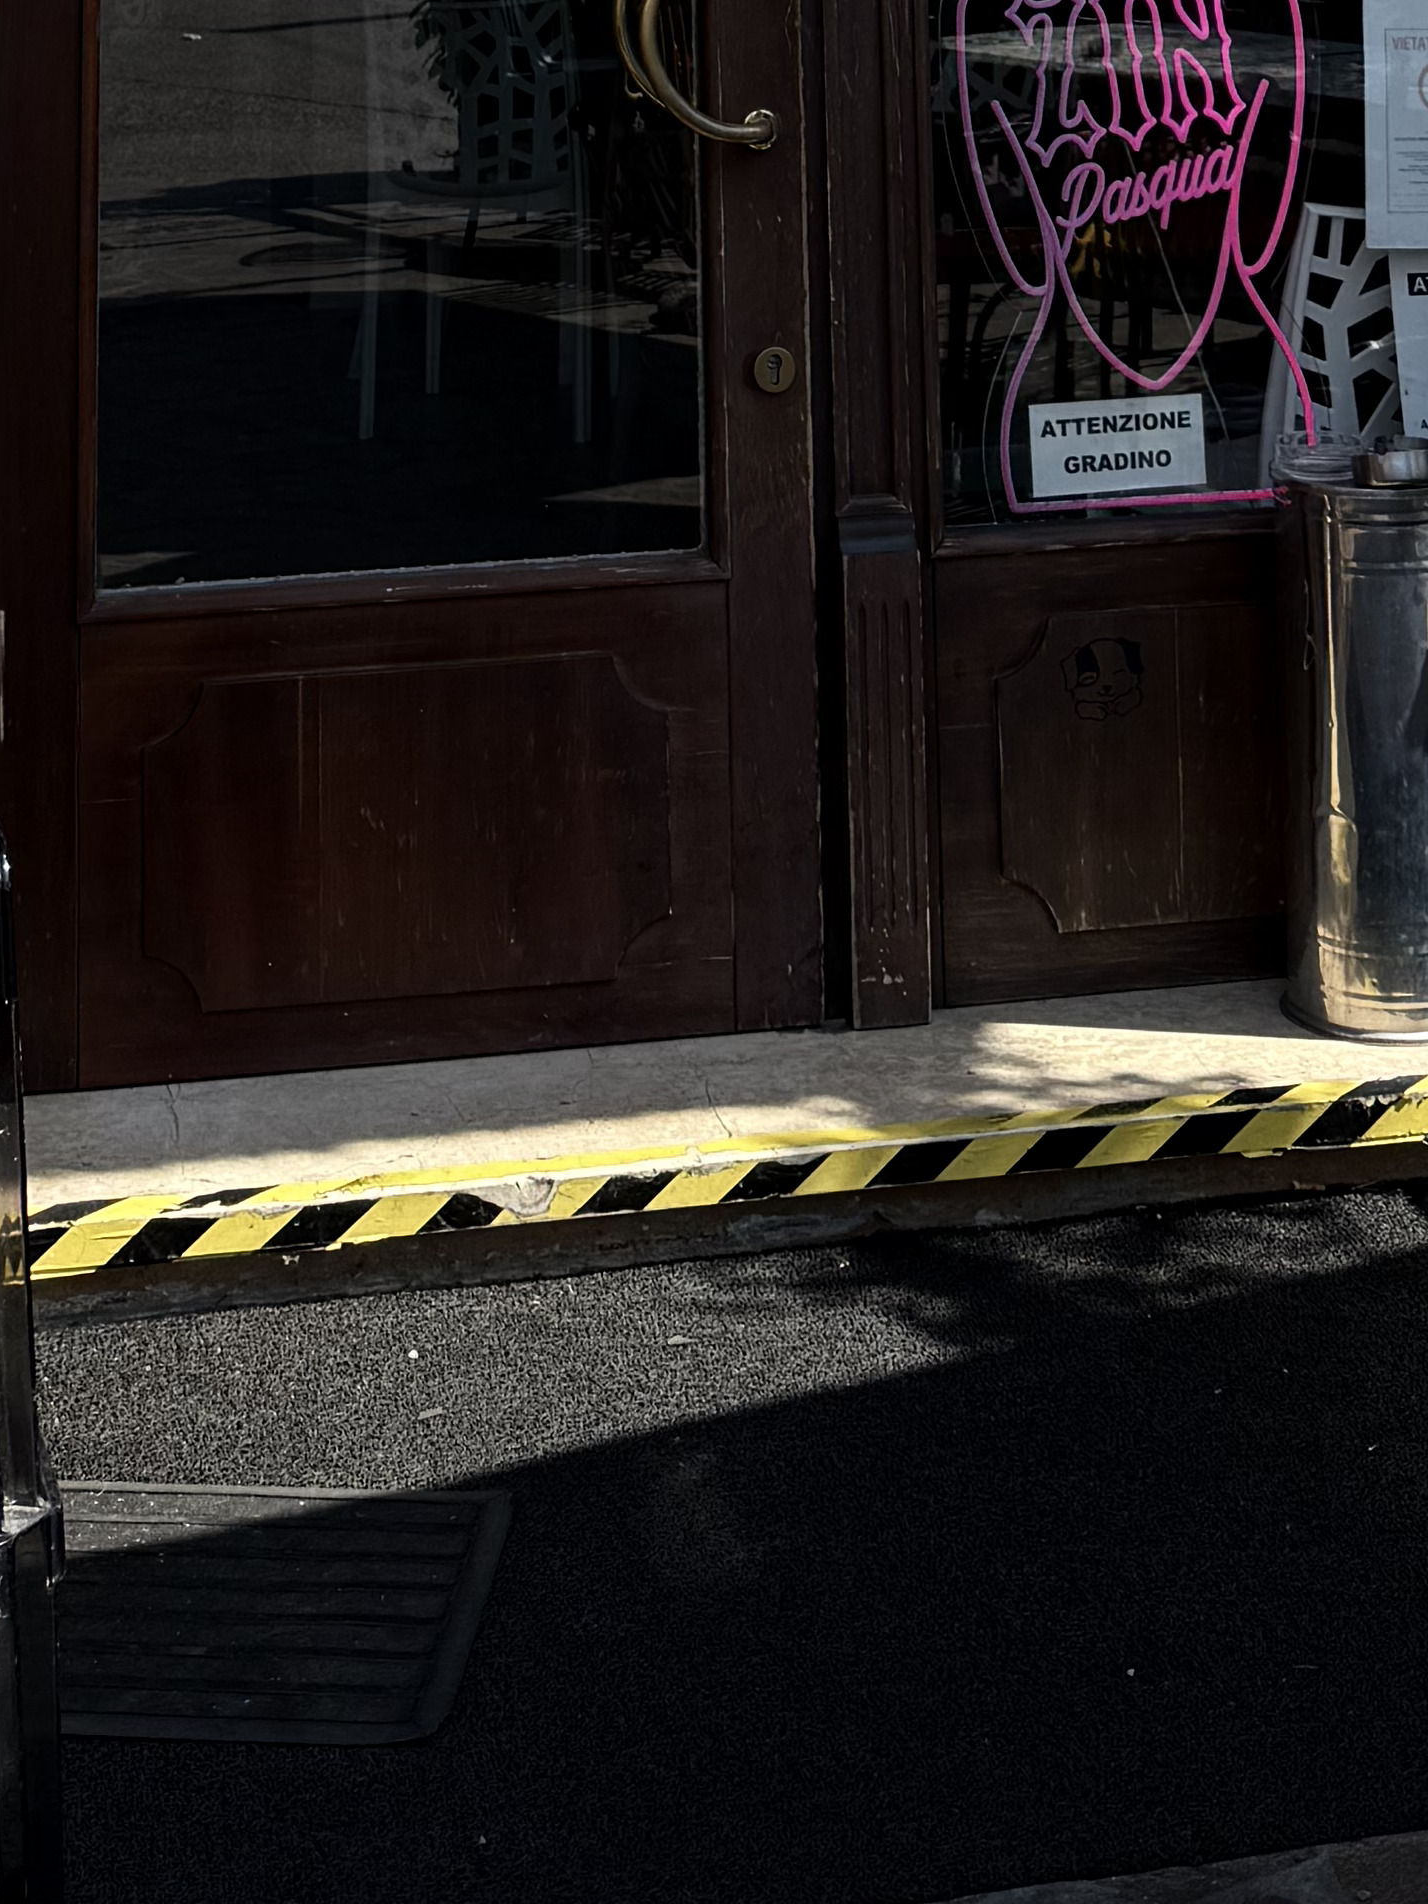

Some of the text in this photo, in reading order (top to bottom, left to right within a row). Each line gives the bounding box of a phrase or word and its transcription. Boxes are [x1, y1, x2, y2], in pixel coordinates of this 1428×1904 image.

[1056, 145, 1236, 230] Pasqua
[1040, 410, 1192, 438] ATTENZIONE
[1421, 419, 1428, 430] A
[1063, 449, 1172, 474] GRADINO
